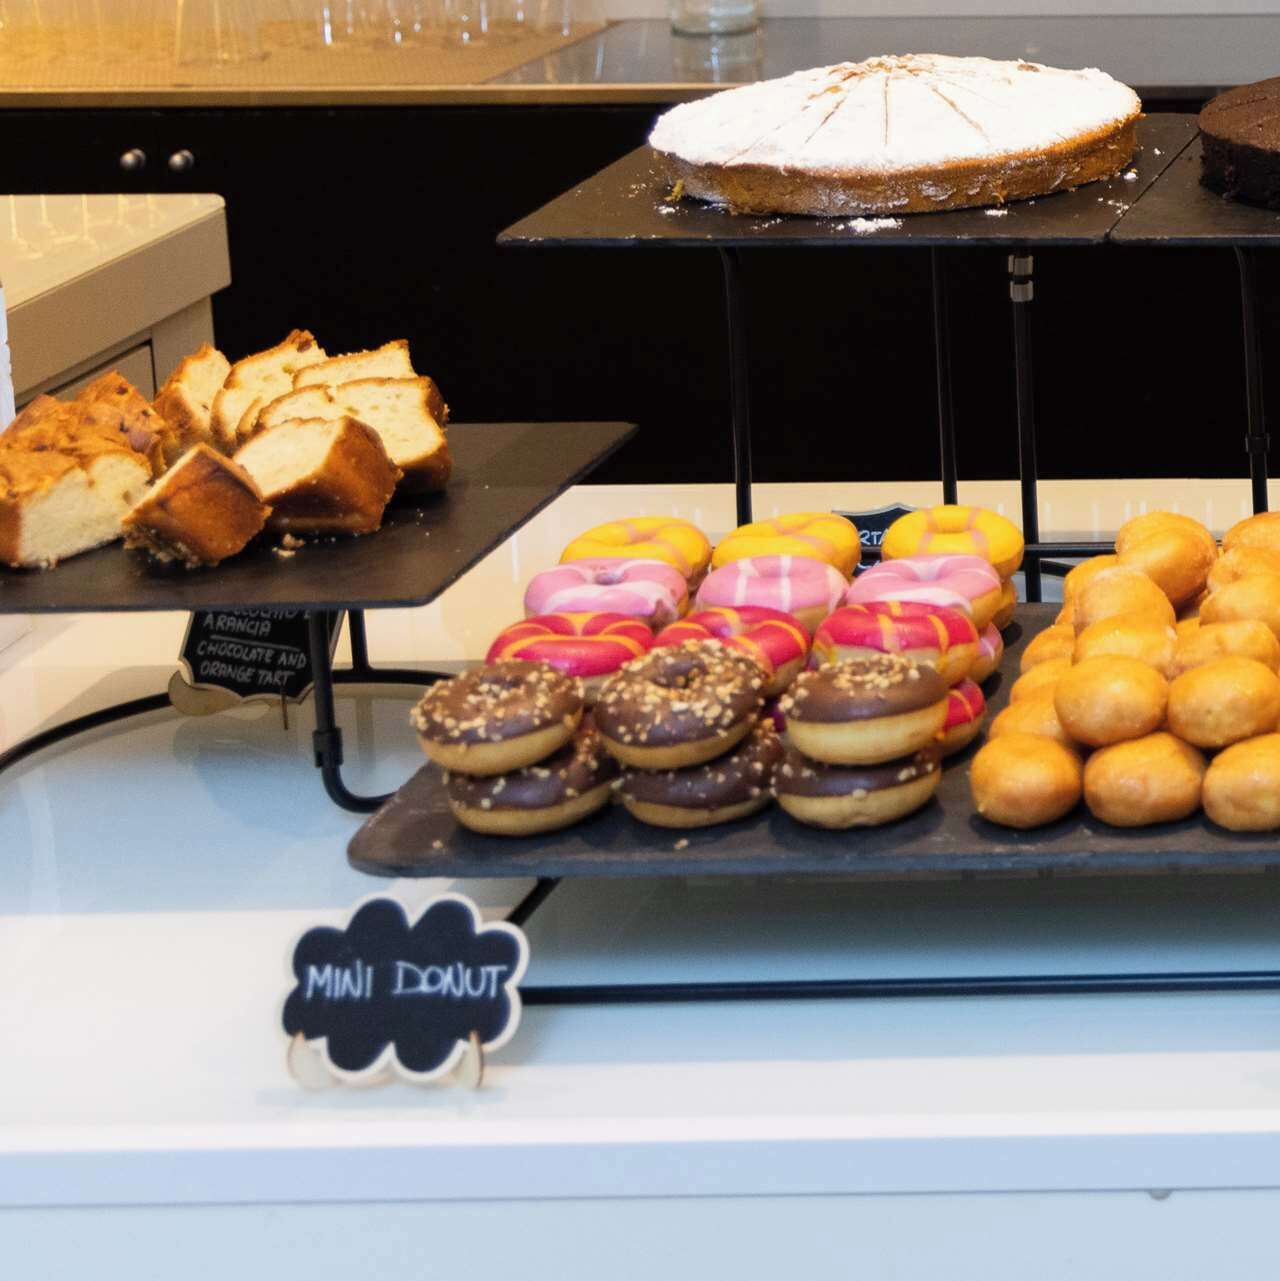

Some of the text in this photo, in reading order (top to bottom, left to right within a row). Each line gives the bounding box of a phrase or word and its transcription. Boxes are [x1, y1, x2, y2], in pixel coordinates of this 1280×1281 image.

[203, 613, 272, 636] ARANCIA
[196, 640, 307, 670] CHOCOLATE AND
[200, 660, 296, 687] ORANGE TART
[305, 959, 509, 1001] MINI DONUT
